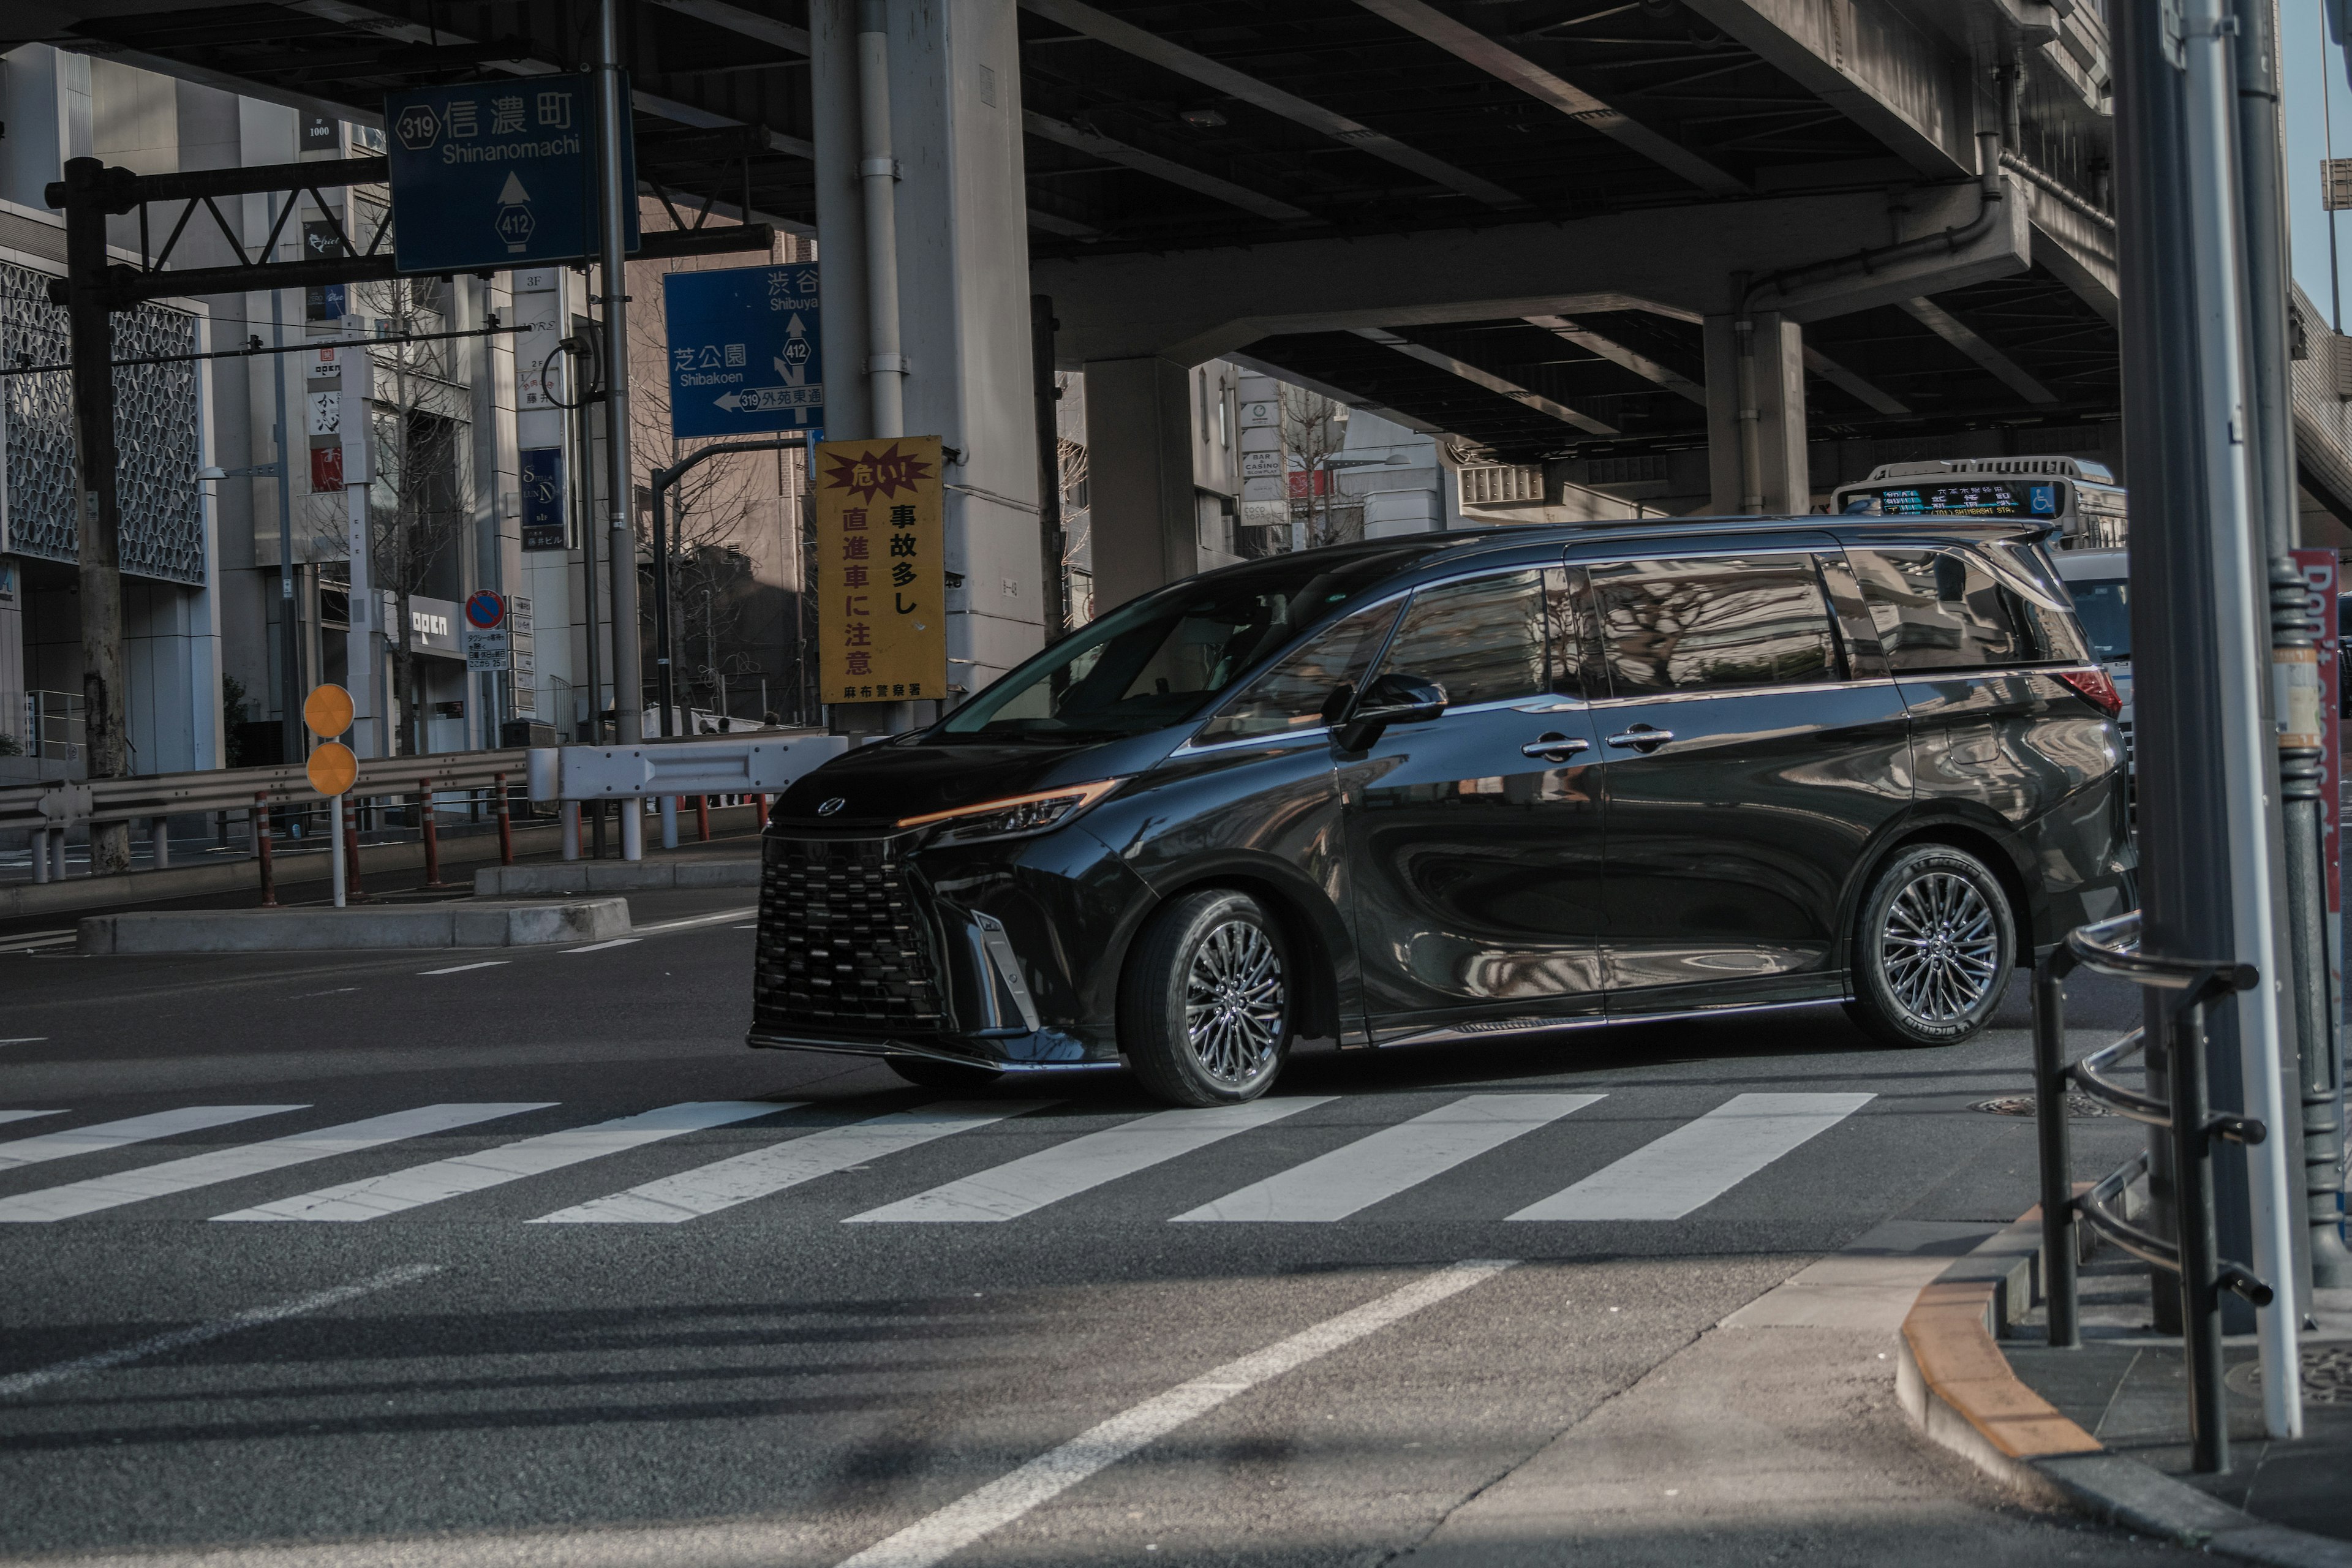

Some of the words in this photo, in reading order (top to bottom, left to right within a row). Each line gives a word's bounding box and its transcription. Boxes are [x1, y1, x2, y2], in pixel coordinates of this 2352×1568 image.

[442, 91, 573, 139] 信濃町
[310, 127, 330, 137] 1000
[402, 117, 434, 140] 319
[442, 134, 580, 165] Shinanomachi
[502, 214, 529, 235] 412
[527, 276, 541, 287] 3F
[767, 270, 818, 296] 渋谷
[770, 297, 818, 312] Shibuya
[673, 343, 747, 372] 芝公園
[786, 344, 806, 358] 412
[680, 372, 743, 387] Shibakoen
[741, 395, 758, 407] 319
[523, 465, 553, 483] STELLA
[528, 536, 562, 546] 藤井ビル
[890, 503, 918, 615] 事故多し
[842, 507, 872, 676] 直進車に注意
[843, 683, 921, 699] 麻布警察署
